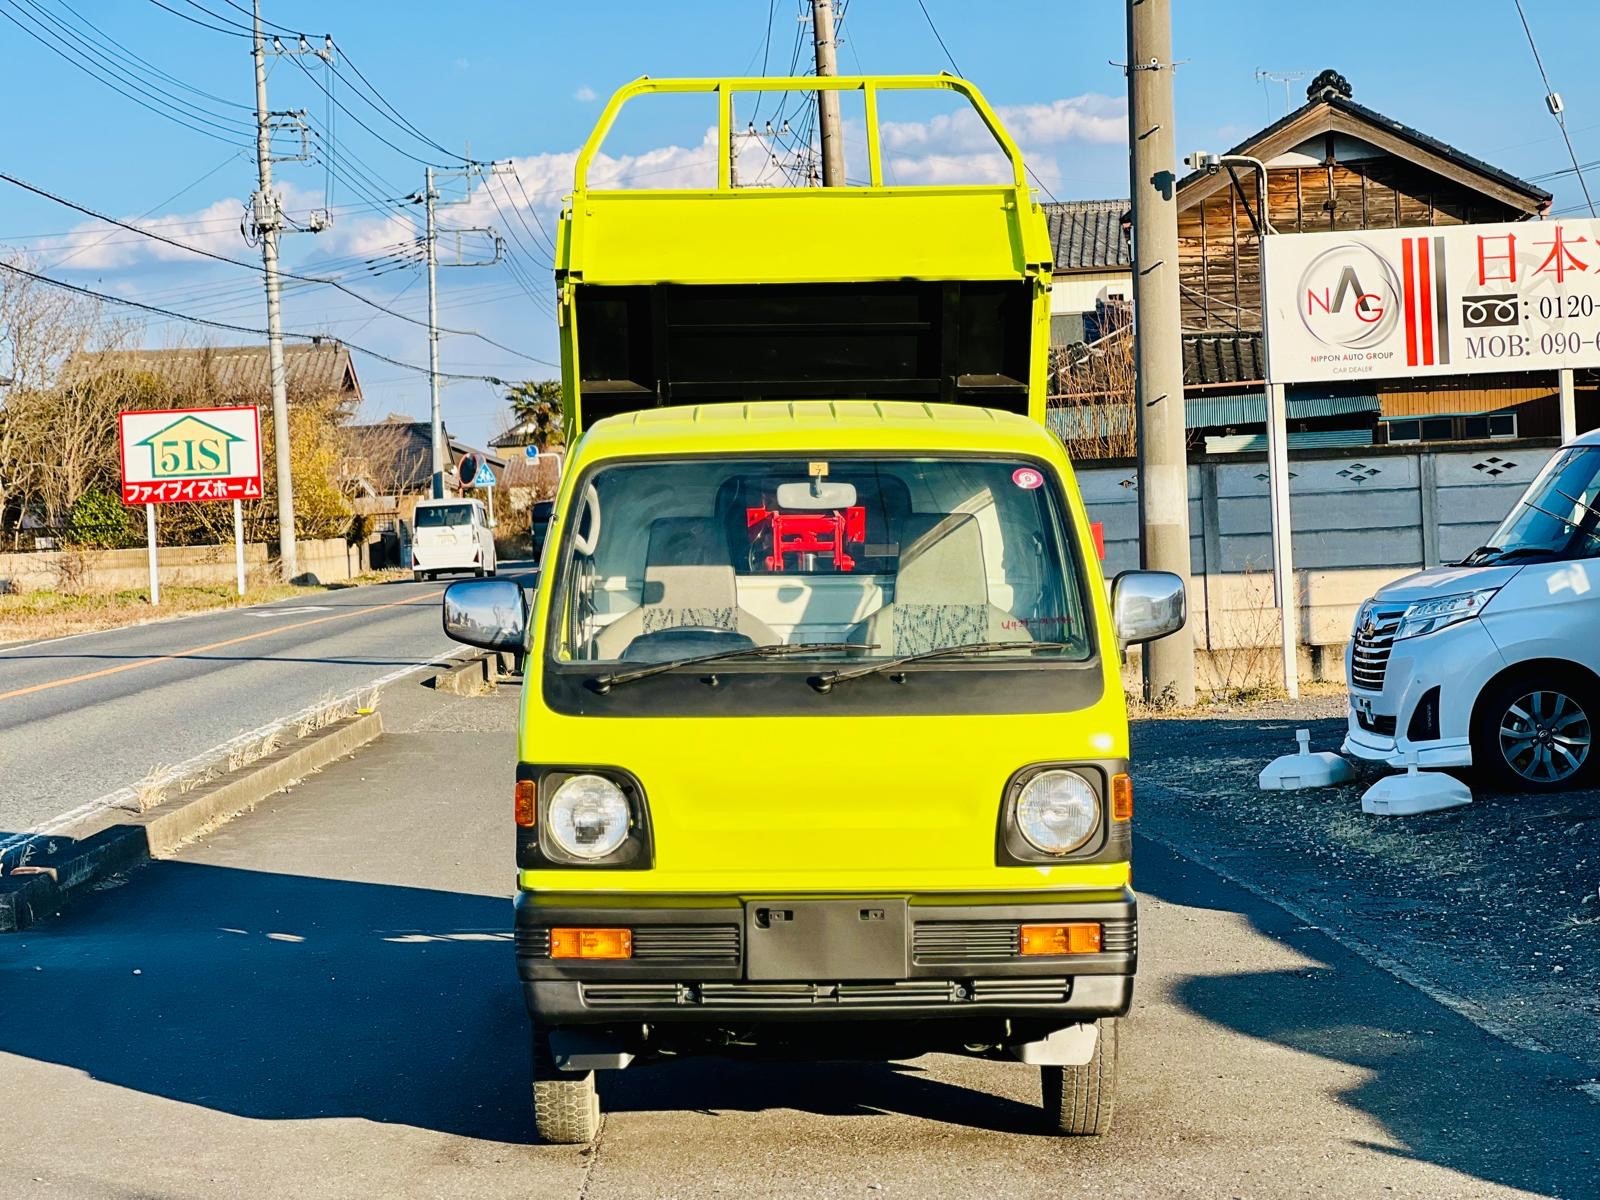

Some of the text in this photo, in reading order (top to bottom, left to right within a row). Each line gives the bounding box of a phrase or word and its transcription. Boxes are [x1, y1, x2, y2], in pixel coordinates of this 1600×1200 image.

[1477, 225, 1600, 286] 日本
[1310, 351, 1394, 363] NIPPON AUTO GROUP
[1465, 334, 1531, 360] MOB:
[160, 439, 222, 473] 5IS
[125, 478, 260, 502] ファイブイズホーム
